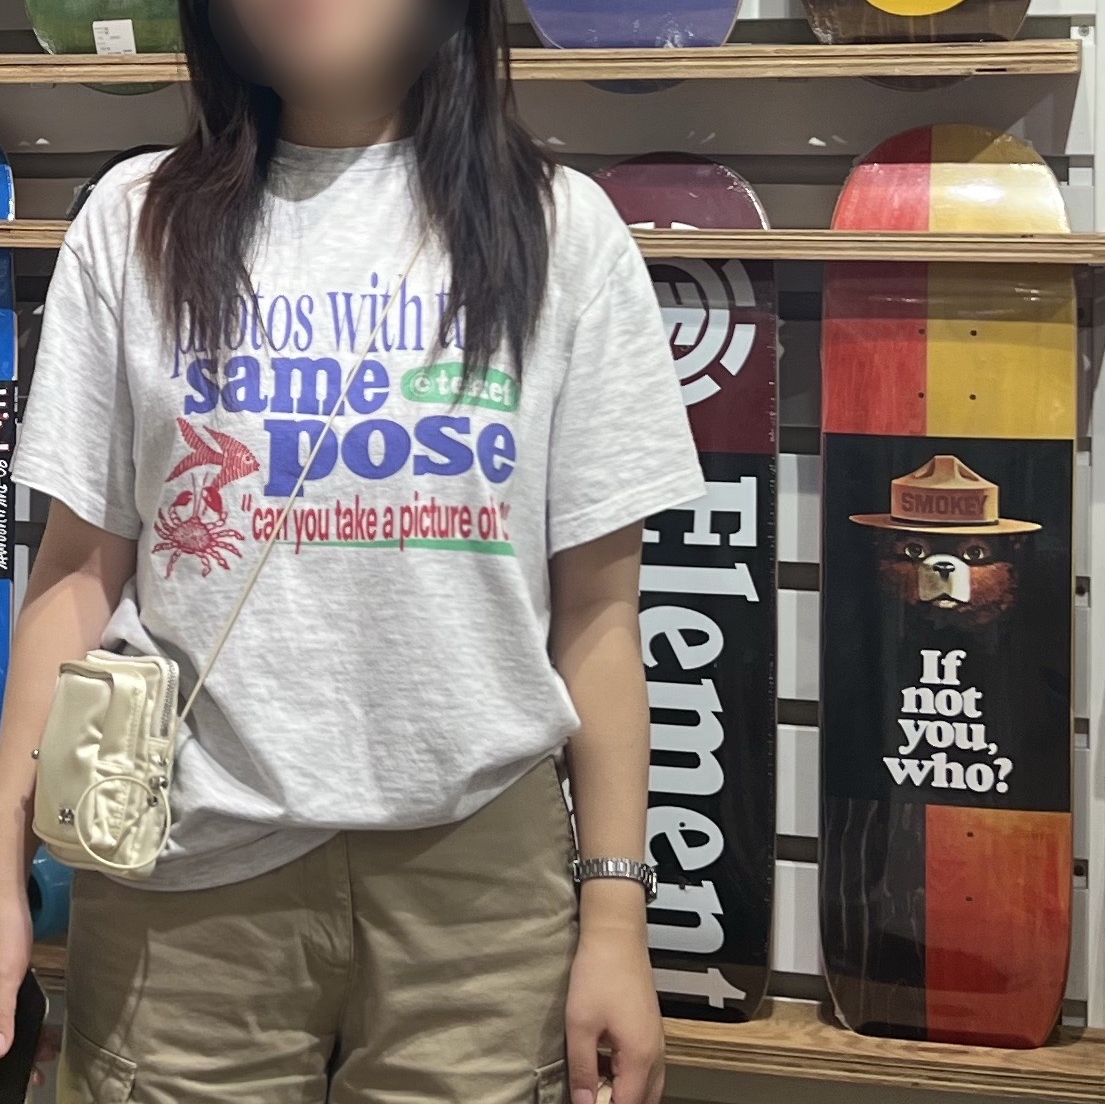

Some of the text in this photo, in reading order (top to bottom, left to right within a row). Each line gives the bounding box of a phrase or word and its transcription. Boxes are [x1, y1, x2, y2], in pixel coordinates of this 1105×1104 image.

[171, 282, 314, 378] potos
[327, 271, 425, 352] with
[184, 354, 390, 416] same
[263, 414, 516, 497] pose
[294, 506, 329, 554] you
[335, 494, 377, 541] take
[382, 506, 394, 540] a
[400, 490, 472, 551] picture
[901, 492, 988, 516] SMOKEY
[919, 649, 966, 685] If
[900, 685, 984, 718] not
[896, 717, 999, 756] you,
[882, 751, 1014, 793] who?
